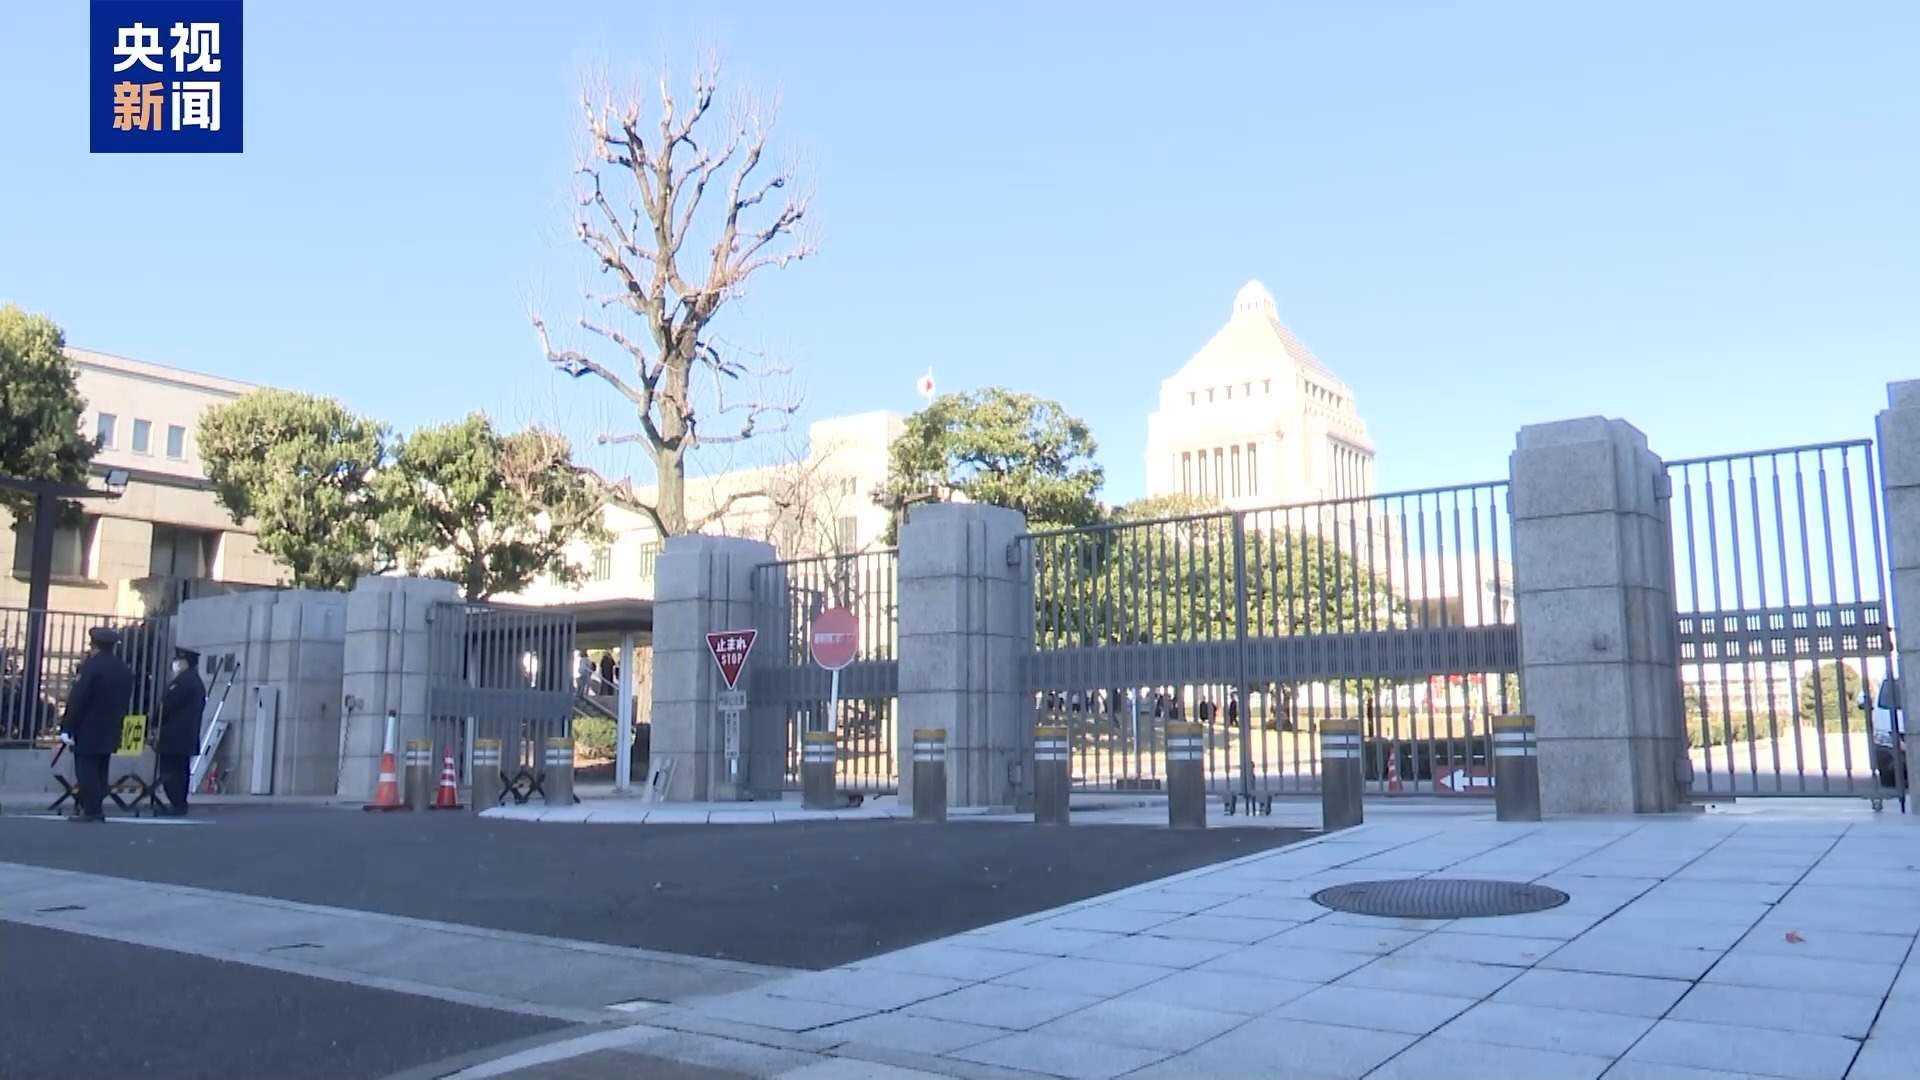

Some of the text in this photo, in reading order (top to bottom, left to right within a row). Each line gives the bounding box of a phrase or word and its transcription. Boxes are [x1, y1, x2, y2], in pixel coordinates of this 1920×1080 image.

[716, 636, 747, 652] 止まれ
[721, 653, 743, 666] STOP
